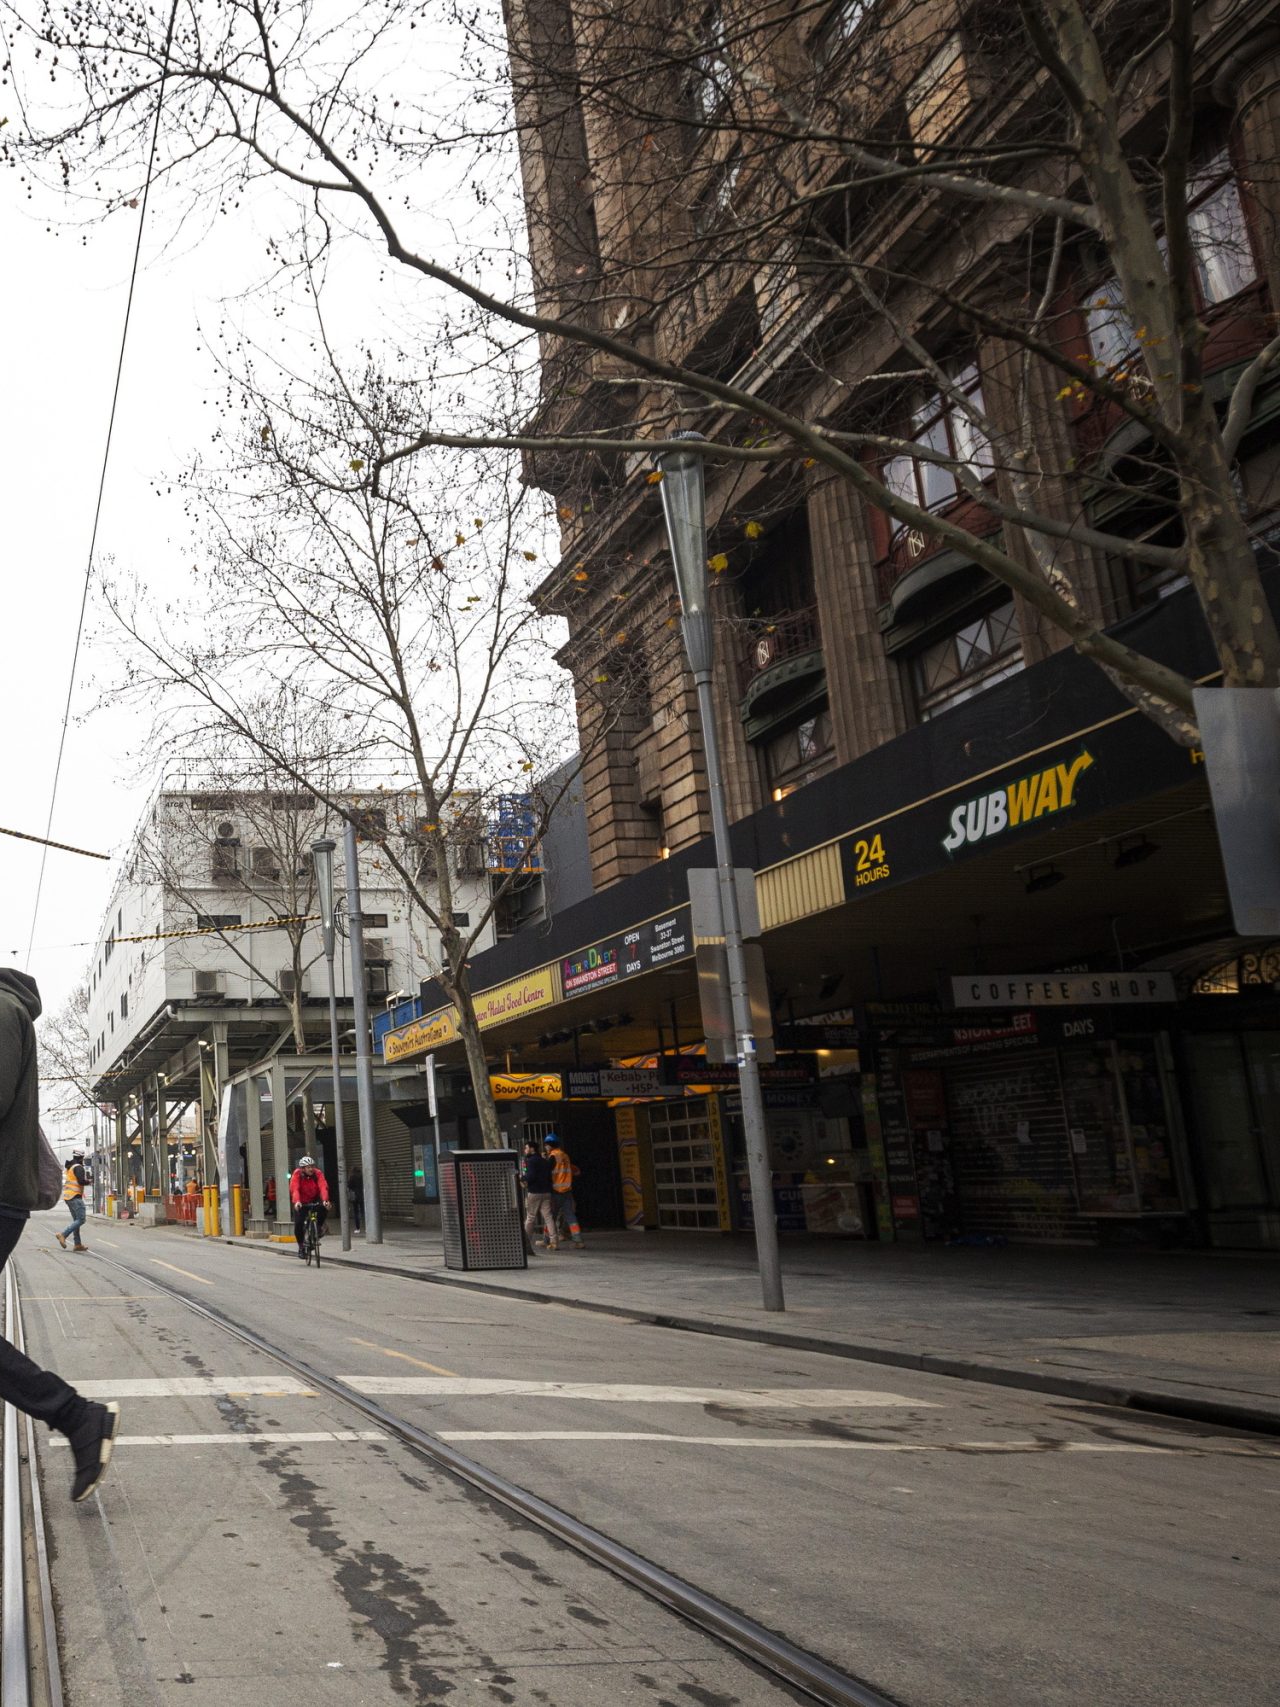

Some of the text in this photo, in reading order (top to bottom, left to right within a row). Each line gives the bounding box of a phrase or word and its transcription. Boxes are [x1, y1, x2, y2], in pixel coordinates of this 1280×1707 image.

[942, 751, 1095, 852] SUBWAY
[854, 833, 886, 872] 24
[855, 864, 890, 887] HOURS
[654, 918, 677, 932] Basement
[624, 931, 640, 946] OPEN
[650, 934, 685, 953] Swanston Street
[629, 944, 638, 959] 7
[651, 948, 674, 962] Melbourne
[626, 960, 641, 973] DAYS
[565, 978, 573, 990] ON
[573, 969, 598, 987] SWANSTON
[597, 962, 617, 978] STREET
[971, 980, 1157, 1000] COFFEE SHOP
[476, 1010, 488, 1022] ston
[487, 1000, 506, 1017] Halal
[506, 992, 523, 1009] Food
[523, 986, 545, 1004] Centre
[952, 1025, 991, 1041] NSTON
[1063, 1018, 1095, 1037] DAYS
[569, 1071, 599, 1084] MONEY
[607, 1071, 641, 1082] Kebab
[495, 1082, 545, 1095] Souvenirs
[631, 1083, 654, 1093] HSP
[766, 1092, 813, 1104] MONEY
